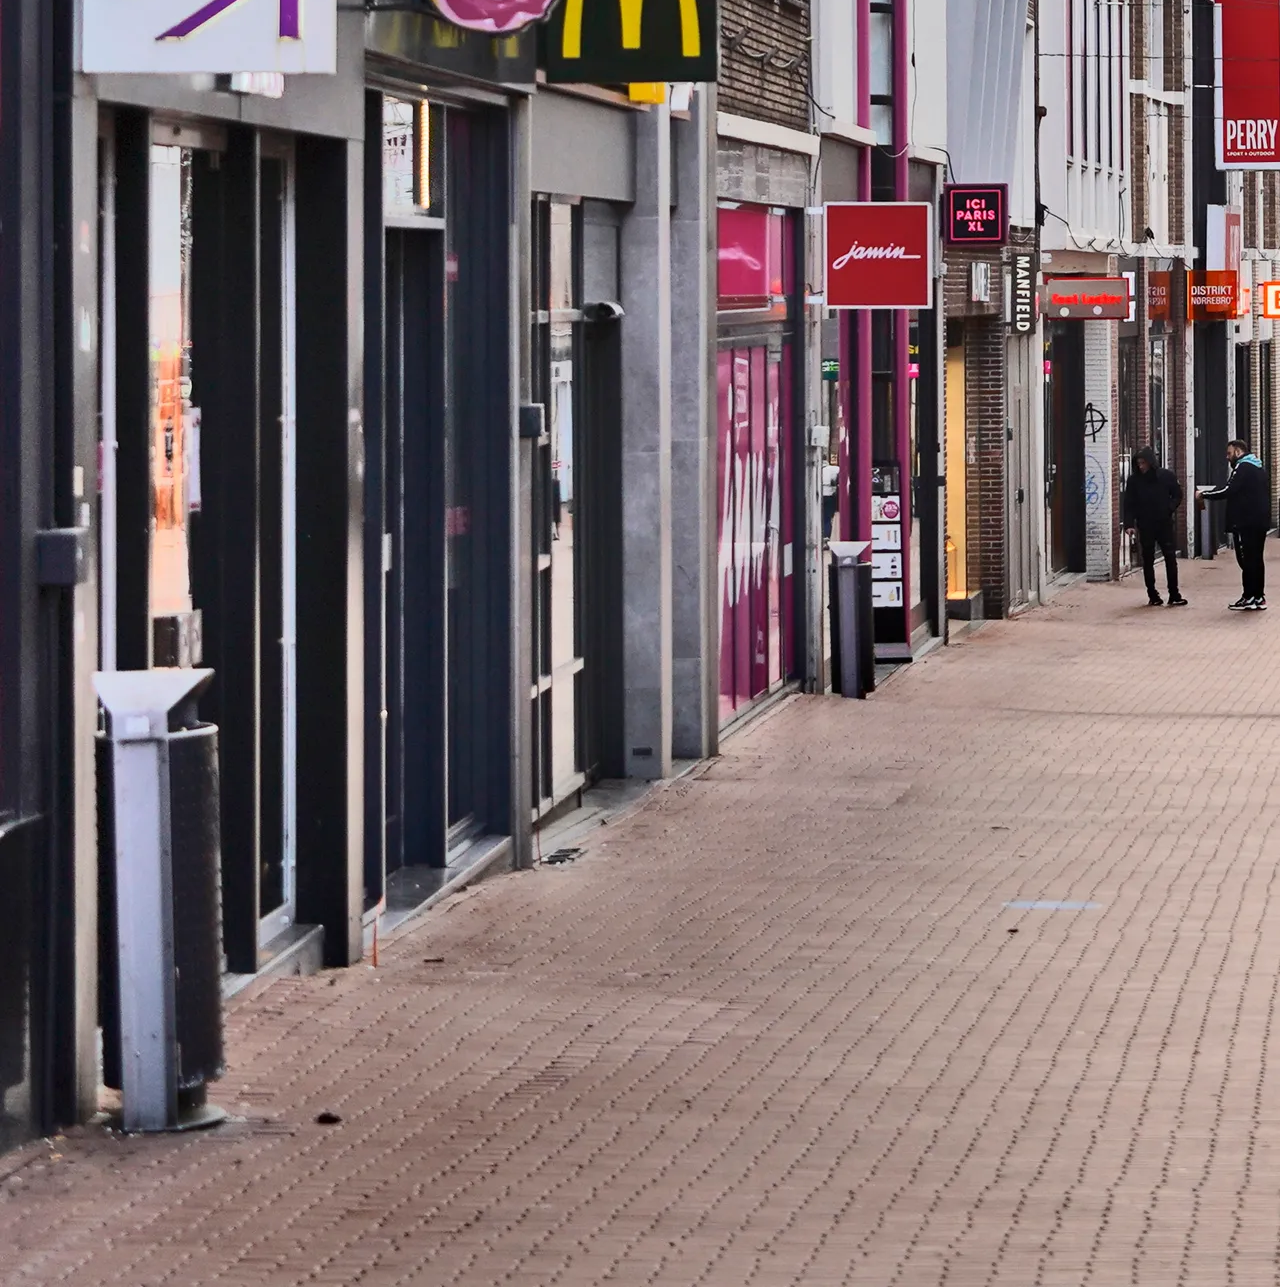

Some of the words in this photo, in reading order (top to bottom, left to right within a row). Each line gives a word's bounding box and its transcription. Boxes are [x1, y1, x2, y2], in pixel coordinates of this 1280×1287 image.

[1226, 119, 1278, 150] PERRY
[966, 199, 985, 209] ICI
[956, 210, 995, 221] PARIS
[967, 221, 984, 231] XL
[832, 241, 921, 270] jamin
[1016, 256, 1030, 332] MANFIELD
[1191, 286, 1232, 296] DISTRIKT
